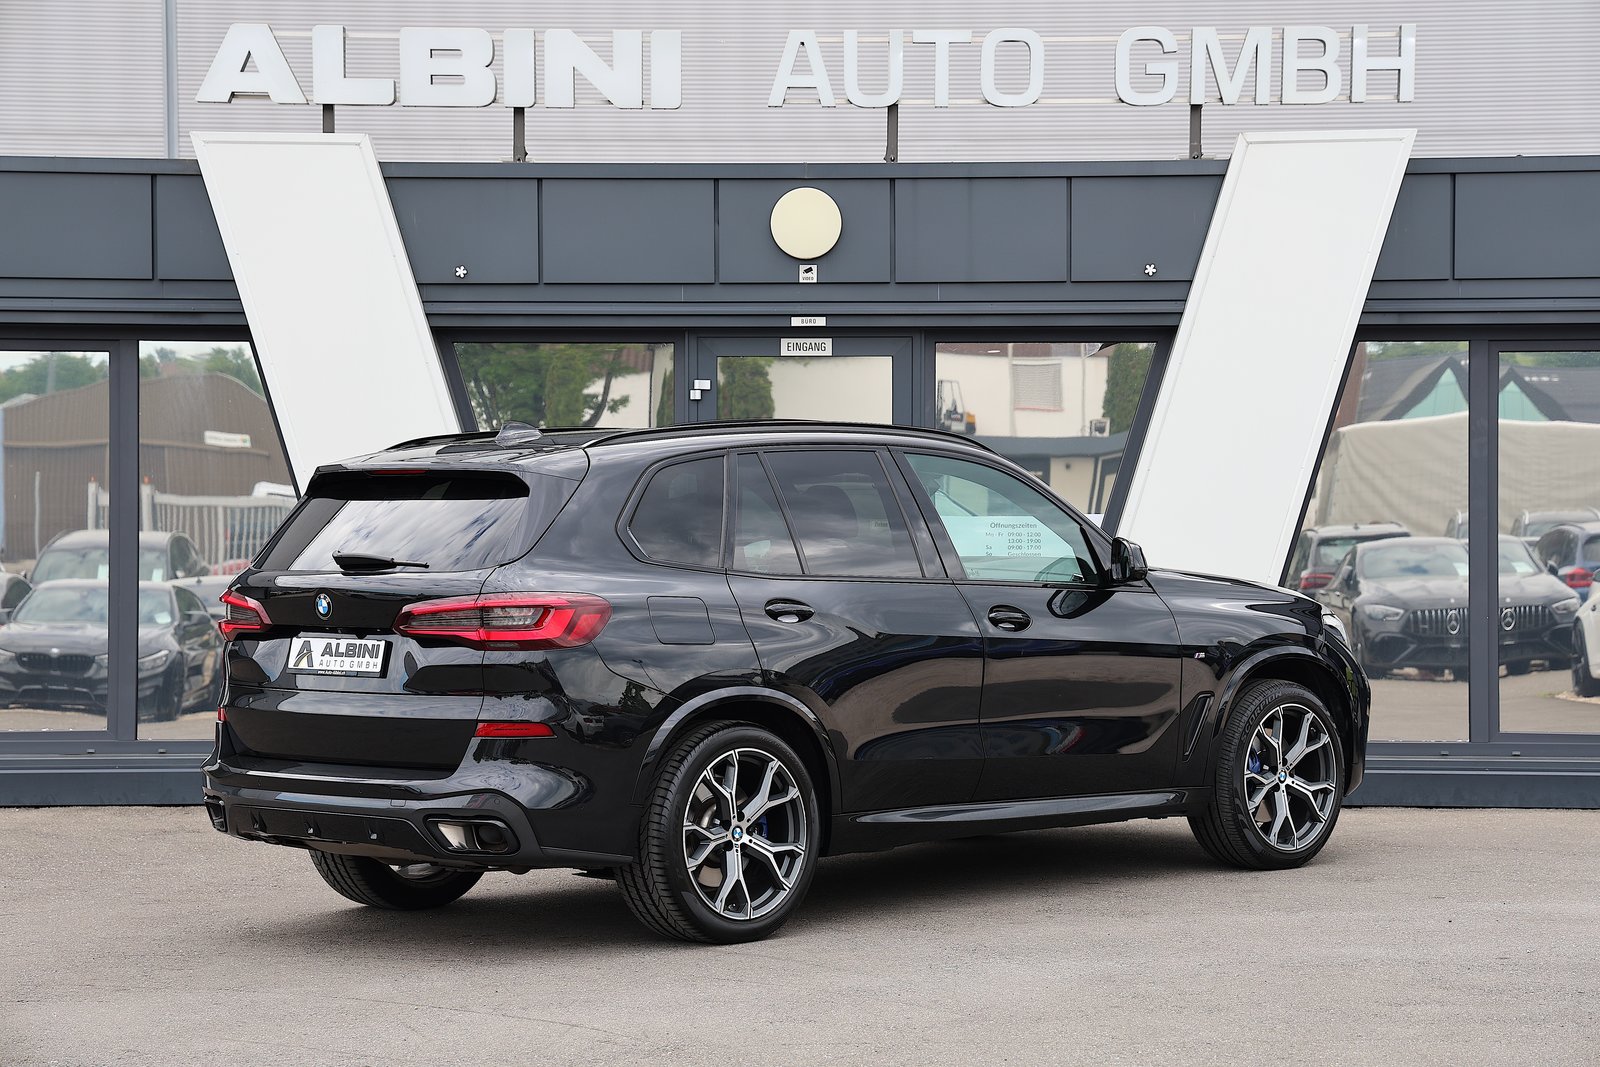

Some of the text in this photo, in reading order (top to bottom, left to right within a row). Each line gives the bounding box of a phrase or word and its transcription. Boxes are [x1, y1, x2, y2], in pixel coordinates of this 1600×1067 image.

[194, 22, 1417, 110] ALBINI AUTO GMBH
[786, 342, 827, 352] EINGANG
[320, 642, 381, 659] ALBINI
[318, 659, 378, 669] AUTO GMBH
